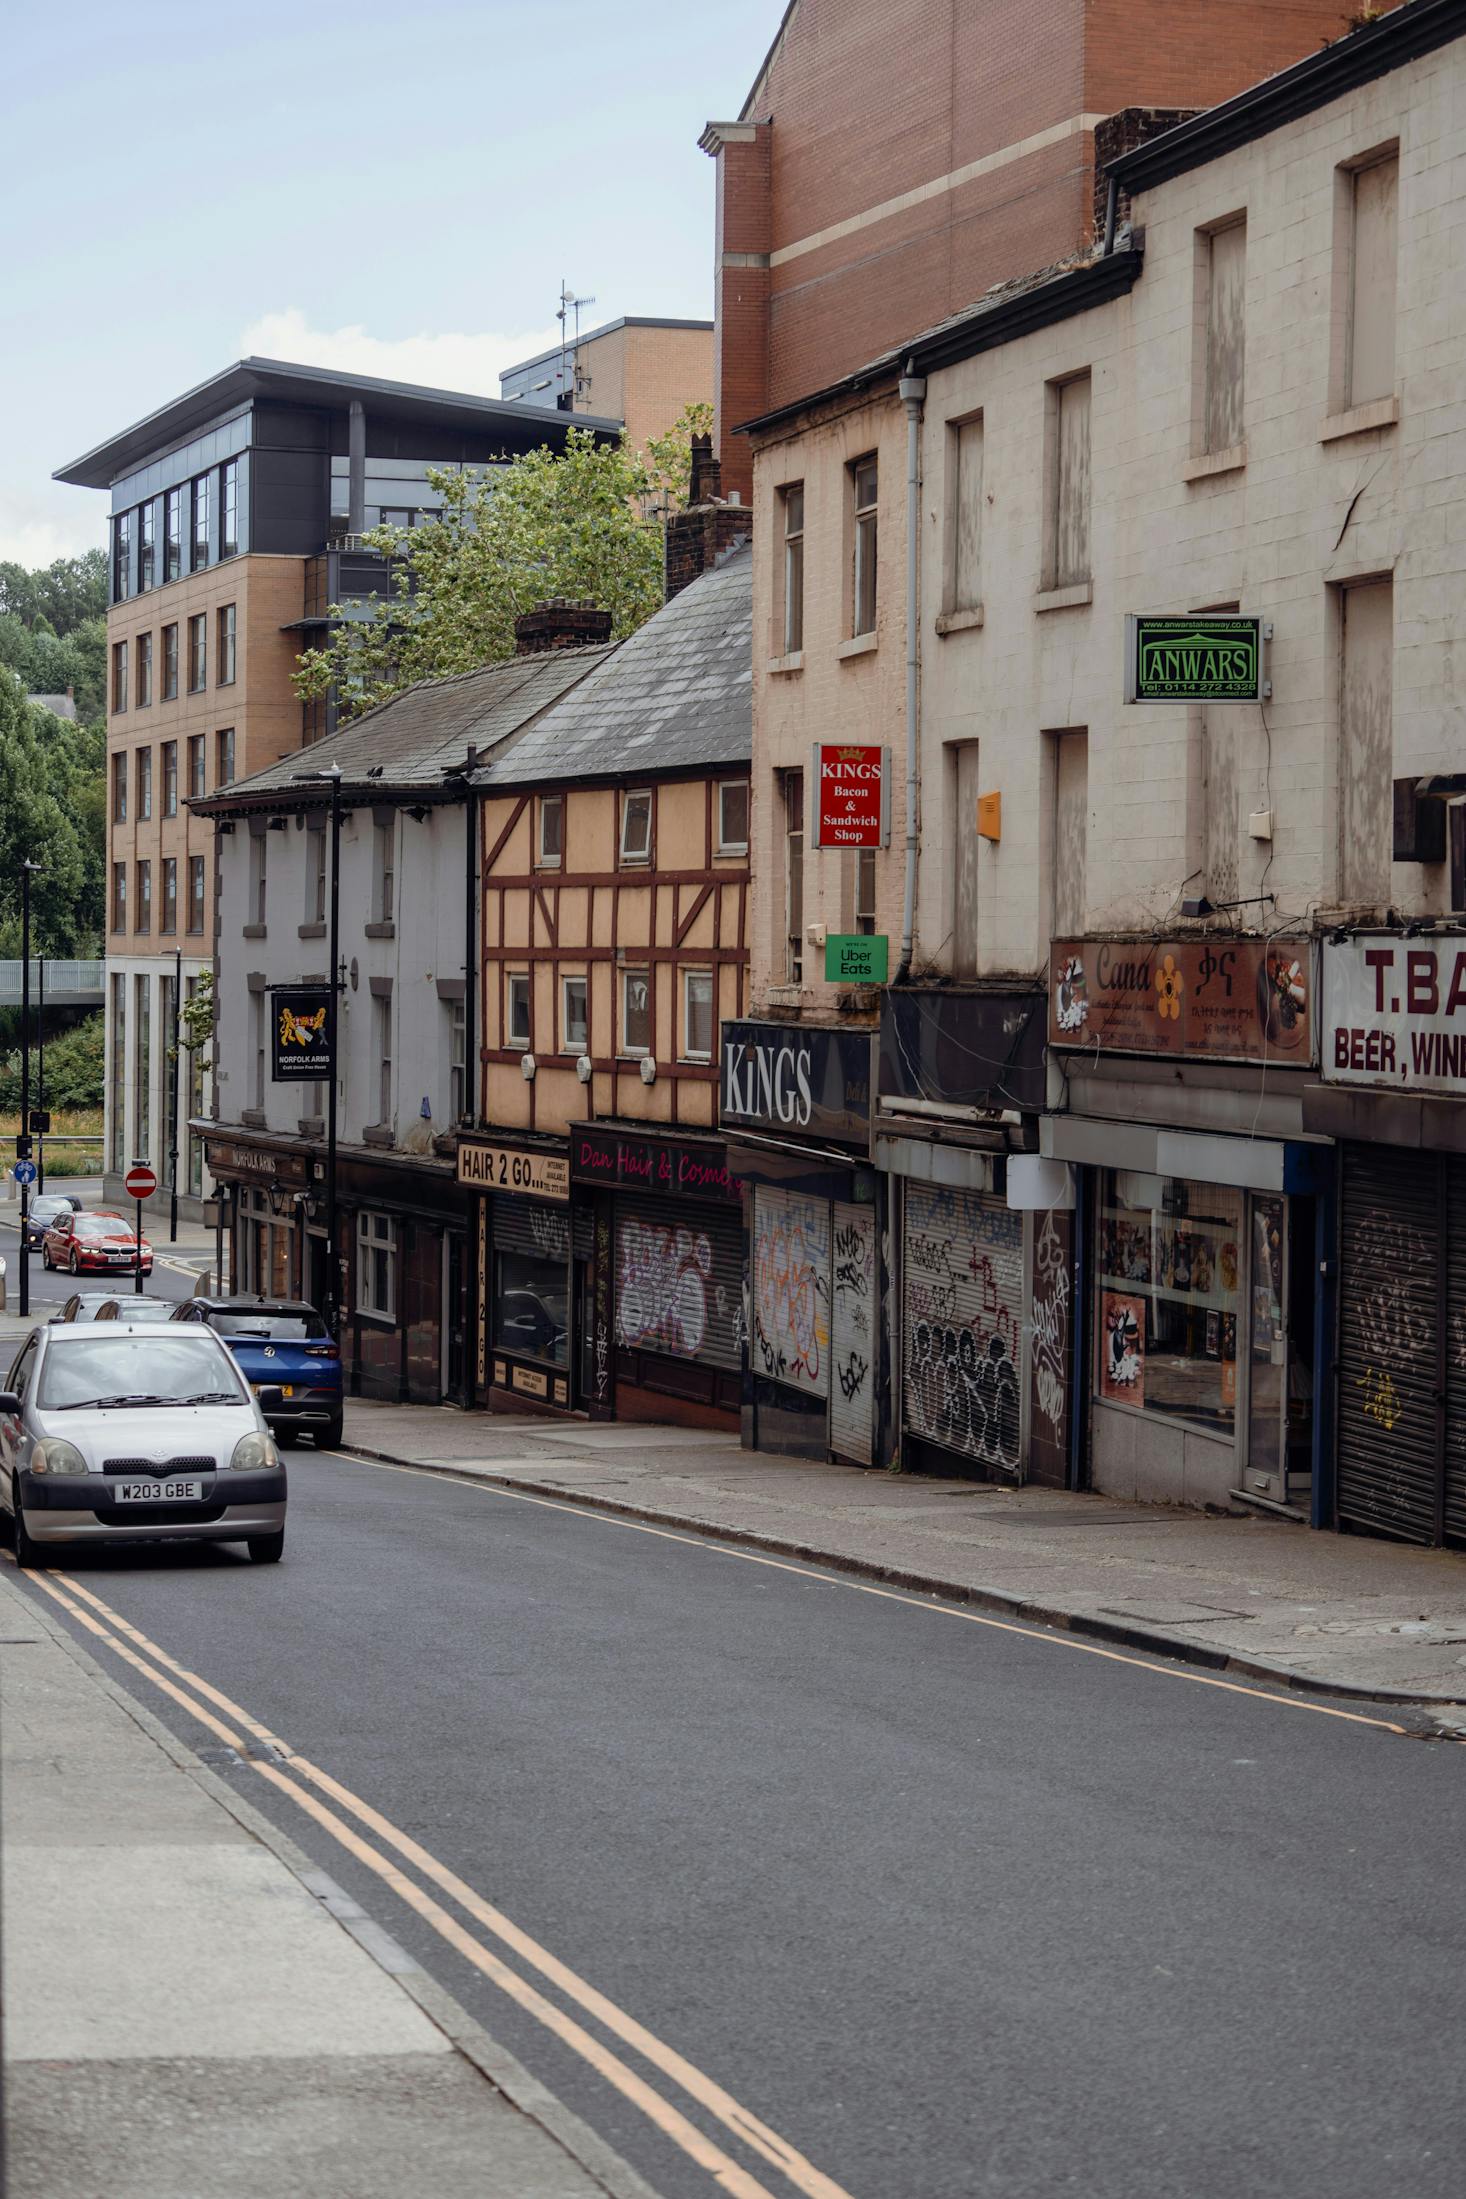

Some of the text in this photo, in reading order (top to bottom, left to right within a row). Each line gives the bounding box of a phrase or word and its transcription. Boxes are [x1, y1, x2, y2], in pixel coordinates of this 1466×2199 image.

[1148, 650, 1248, 681] ANWARS
[1165, 683, 1196, 691] 0114
[1200, 683, 1222, 691] 272
[1225, 683, 1256, 691] 4328
[822, 763, 881, 779] KINGS
[834, 786, 869, 797] Bacon
[845, 800, 856, 811] &
[823, 814, 878, 826] Sandwich
[834, 829, 863, 843] Shop
[841, 949, 872, 961] Uber
[841, 963, 872, 974] Eats
[1097, 944, 1152, 991] Cana
[279, 1055, 330, 1063] NORFOLK ARMS
[232, 1149, 259, 1170] NORFOLK
[259, 1153, 277, 1173] ARMS
[463, 1149, 494, 1181] HAIR
[499, 1153, 508, 1185] 2
[580, 1141, 613, 1168] Dan
[617, 1146, 654, 1176] Hair
[658, 1152, 672, 1179] &
[122, 1483, 194, 1499] W203 GBE
